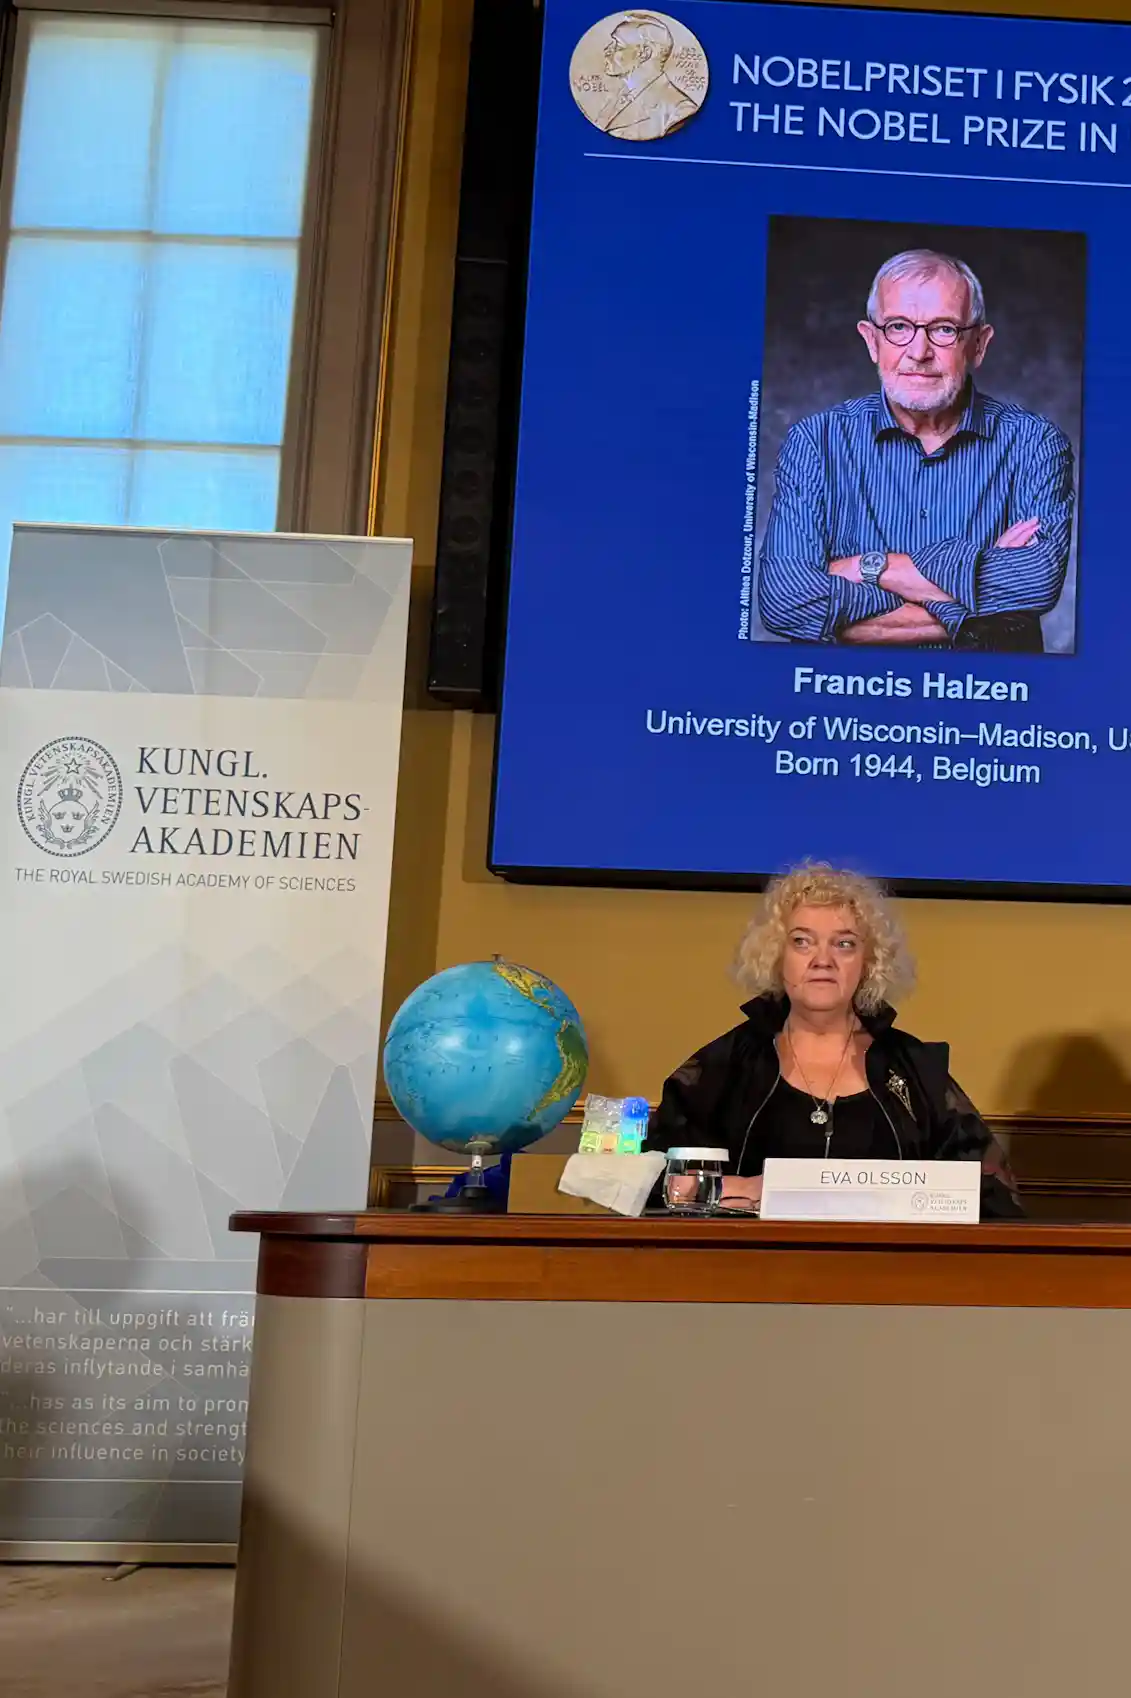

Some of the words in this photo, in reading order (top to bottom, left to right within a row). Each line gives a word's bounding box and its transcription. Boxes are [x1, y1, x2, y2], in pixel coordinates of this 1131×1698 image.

[733, 54, 987, 98] NOBELPRISET
[996, 69, 1003, 99] I
[1015, 70, 1114, 106] FYSIK
[730, 102, 804, 135] THE
[818, 107, 950, 144] NOBEL
[964, 115, 1066, 150] PRIZE
[1080, 121, 1117, 153] IN
[746, 472, 756, 483] of
[743, 484, 757, 532] University
[739, 576, 751, 607] Althea
[737, 608, 749, 640] Photo:
[794, 666, 912, 698] Francis
[923, 672, 1029, 702] Halzen
[646, 709, 781, 744] University
[788, 715, 818, 740] of
[136, 746, 268, 779] KUNGL.
[775, 750, 839, 776] Born
[850, 753, 923, 783] 1944,
[933, 756, 1041, 788] Belgium
[134, 786, 371, 821] VETENSKAPS-
[129, 825, 362, 861] AKADEMIEN
[15, 867, 45, 883] THE
[50, 869, 99, 885] ROYAL
[101, 871, 171, 888] SWEDISH
[176, 873, 251, 890] ACADEMY
[254, 875, 276, 890] OF
[279, 876, 357, 892] SCIENCES
[820, 1171, 852, 1185] EVA
[857, 1171, 927, 1186] OLSSON
[75, 1308, 101, 1325] till
[110, 1309, 179, 1330] uppgift
[187, 1312, 213, 1327] att
[2, 1333, 151, 1353] vetenskaperna
[159, 1334, 192, 1351] och
[0, 1356, 56, 1374] deras
[64, 1357, 163, 1379] inflytande
[71, 1396, 94, 1410] as
[102, 1393, 126, 1411] its
[134, 1395, 170, 1412] aim
[178, 1397, 196, 1412] to
[36, 1420, 125, 1435] sciences
[132, 1419, 168, 1436] and
[52, 1442, 144, 1461] influence
[152, 1443, 168, 1460] in
[176, 1444, 246, 1468] society
